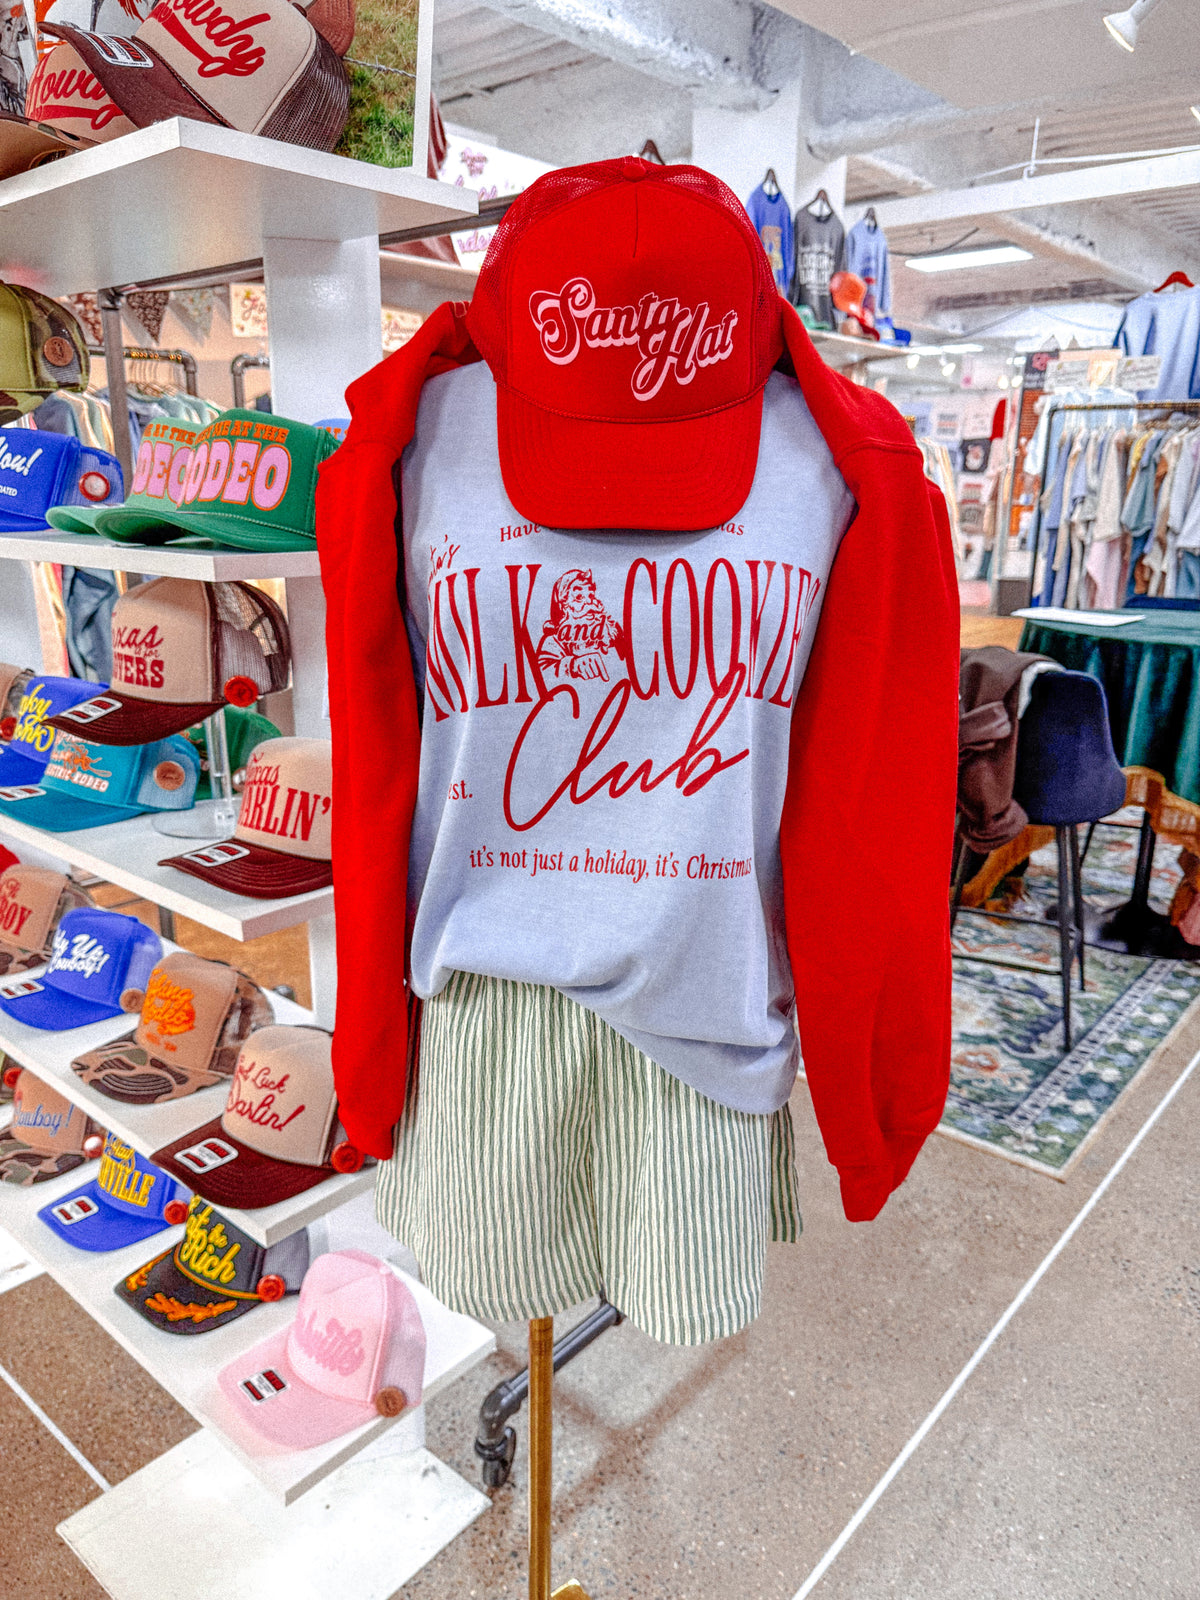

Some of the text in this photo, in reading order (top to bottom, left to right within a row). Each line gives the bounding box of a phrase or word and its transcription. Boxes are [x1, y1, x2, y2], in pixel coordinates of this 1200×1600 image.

[529, 277, 738, 402] Santa Hat
[230, 420, 254, 436] AT
[254, 423, 290, 444] THE
[558, 616, 606, 642] and
[503, 662, 750, 832] Club
[238, 784, 332, 842] ARLIN'
[469, 845, 495, 868] it's
[499, 849, 528, 869] not
[530, 848, 564, 877] just
[568, 855, 580, 872] a
[583, 848, 650, 884] holiday,
[655, 851, 680, 878] it's
[252, 1066, 291, 1094] Luck
[207, 1222, 228, 1248] the
[180, 1229, 242, 1284] Rich
